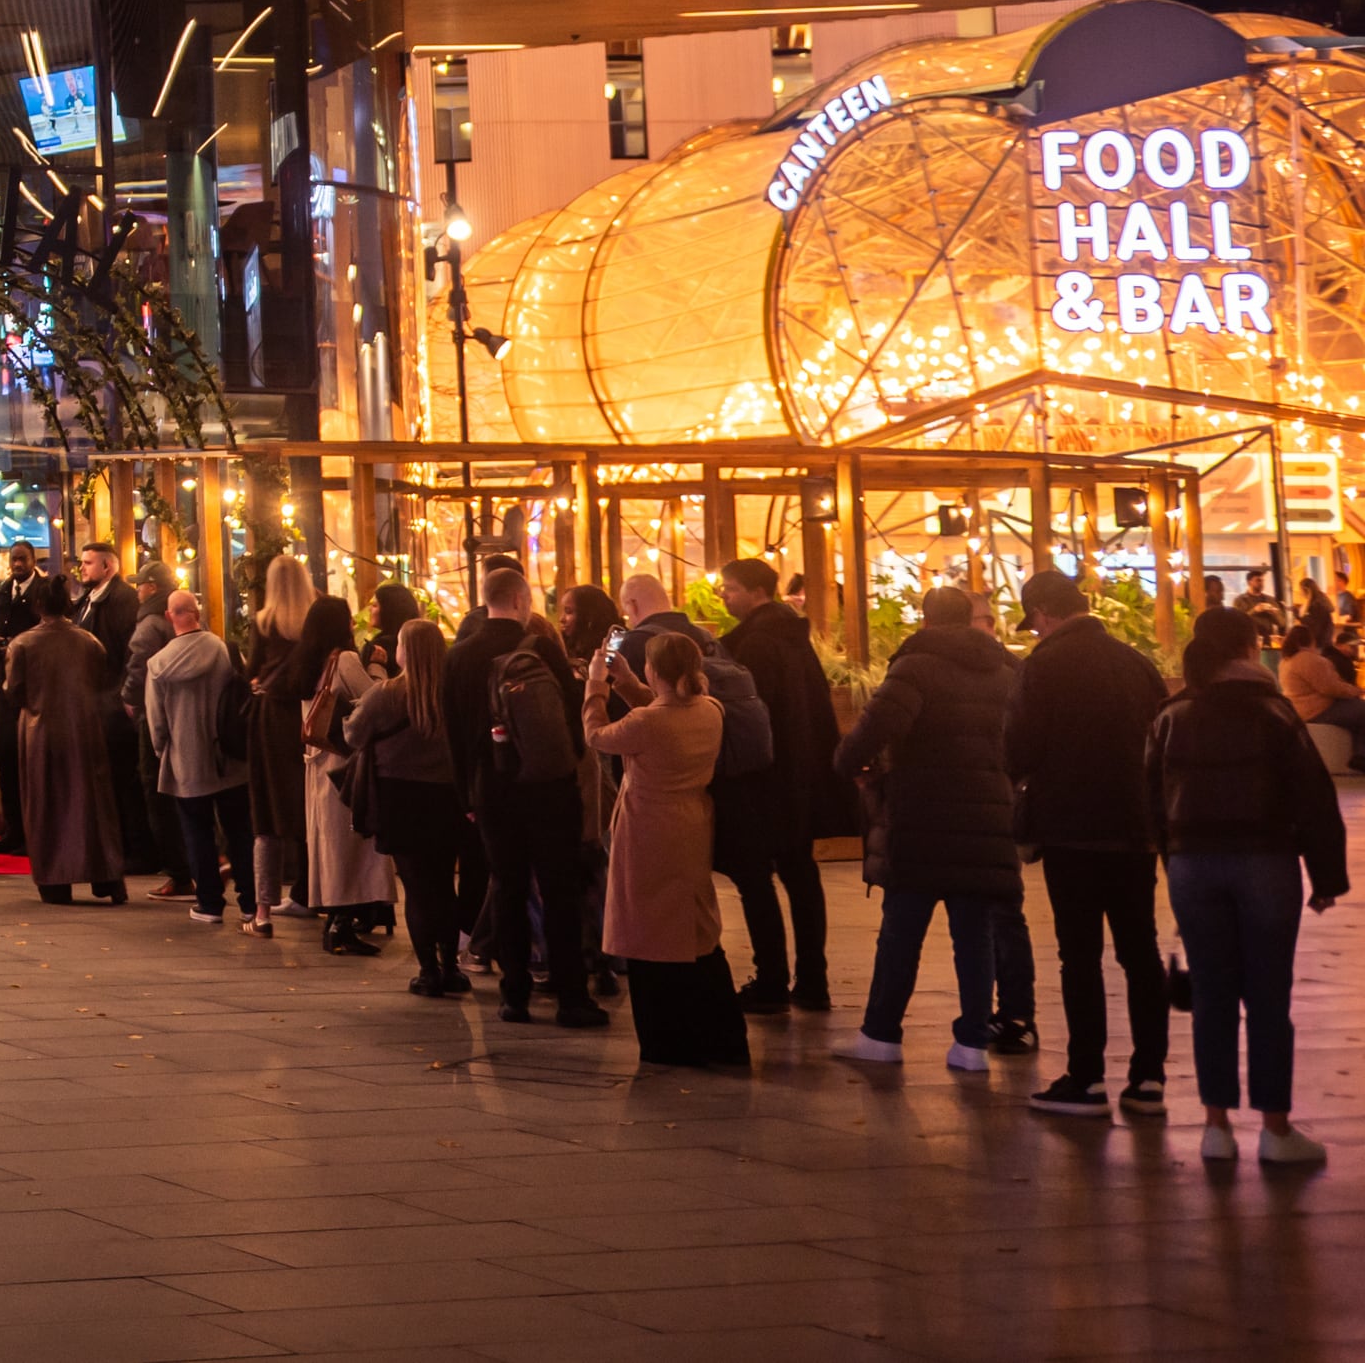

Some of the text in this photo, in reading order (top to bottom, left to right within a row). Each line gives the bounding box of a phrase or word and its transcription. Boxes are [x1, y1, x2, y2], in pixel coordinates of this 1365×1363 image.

[767, 74, 892, 213] CANTEEN
[1041, 128, 1251, 191] FOOD
[1057, 201, 1252, 262] HALL
